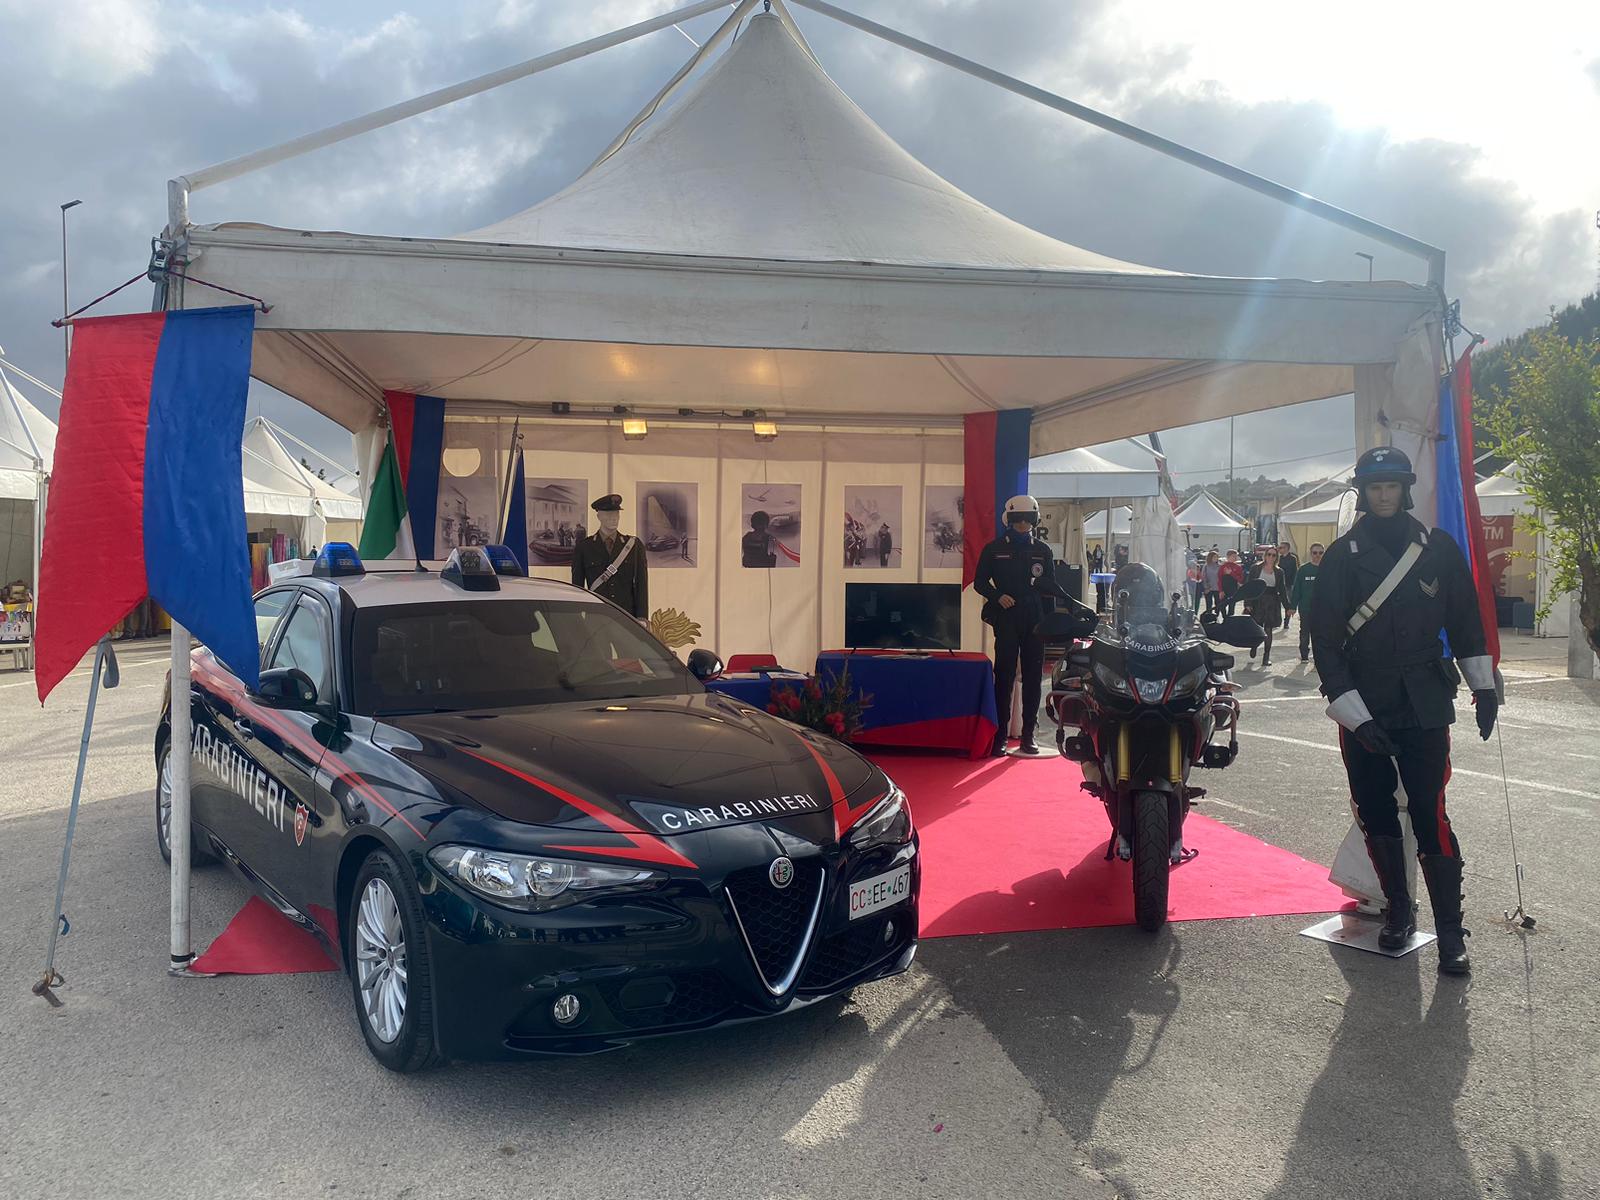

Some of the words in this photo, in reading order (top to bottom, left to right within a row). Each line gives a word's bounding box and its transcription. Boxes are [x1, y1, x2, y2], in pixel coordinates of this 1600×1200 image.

[1124, 636, 1180, 652] CARABINIERI
[189, 718, 287, 833] ARABINIERI
[661, 793, 819, 830] CARABINIERI
[851, 889, 866, 911] CC
[873, 881, 887, 904] EE
[892, 871, 910, 896] 467
